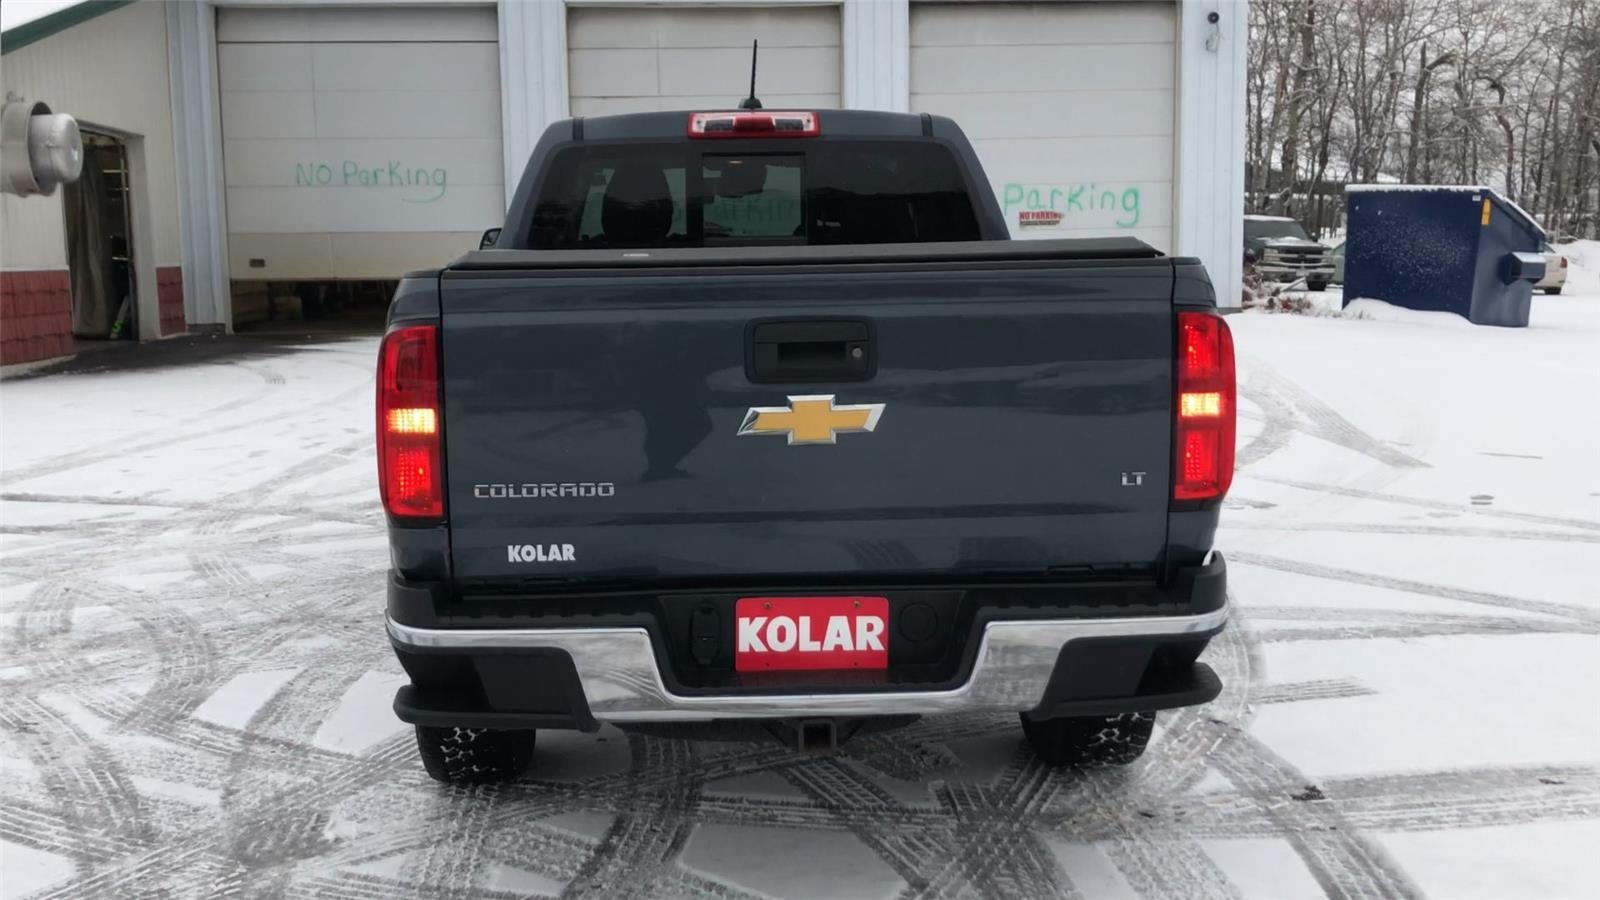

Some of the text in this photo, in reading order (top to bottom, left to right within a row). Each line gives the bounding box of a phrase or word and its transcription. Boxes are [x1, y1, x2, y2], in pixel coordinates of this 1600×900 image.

[1121, 471, 1147, 486] LT
[473, 482, 616, 499] COLORADO
[507, 543, 576, 563] KOLAR
[737, 615, 886, 653] KOLAR
